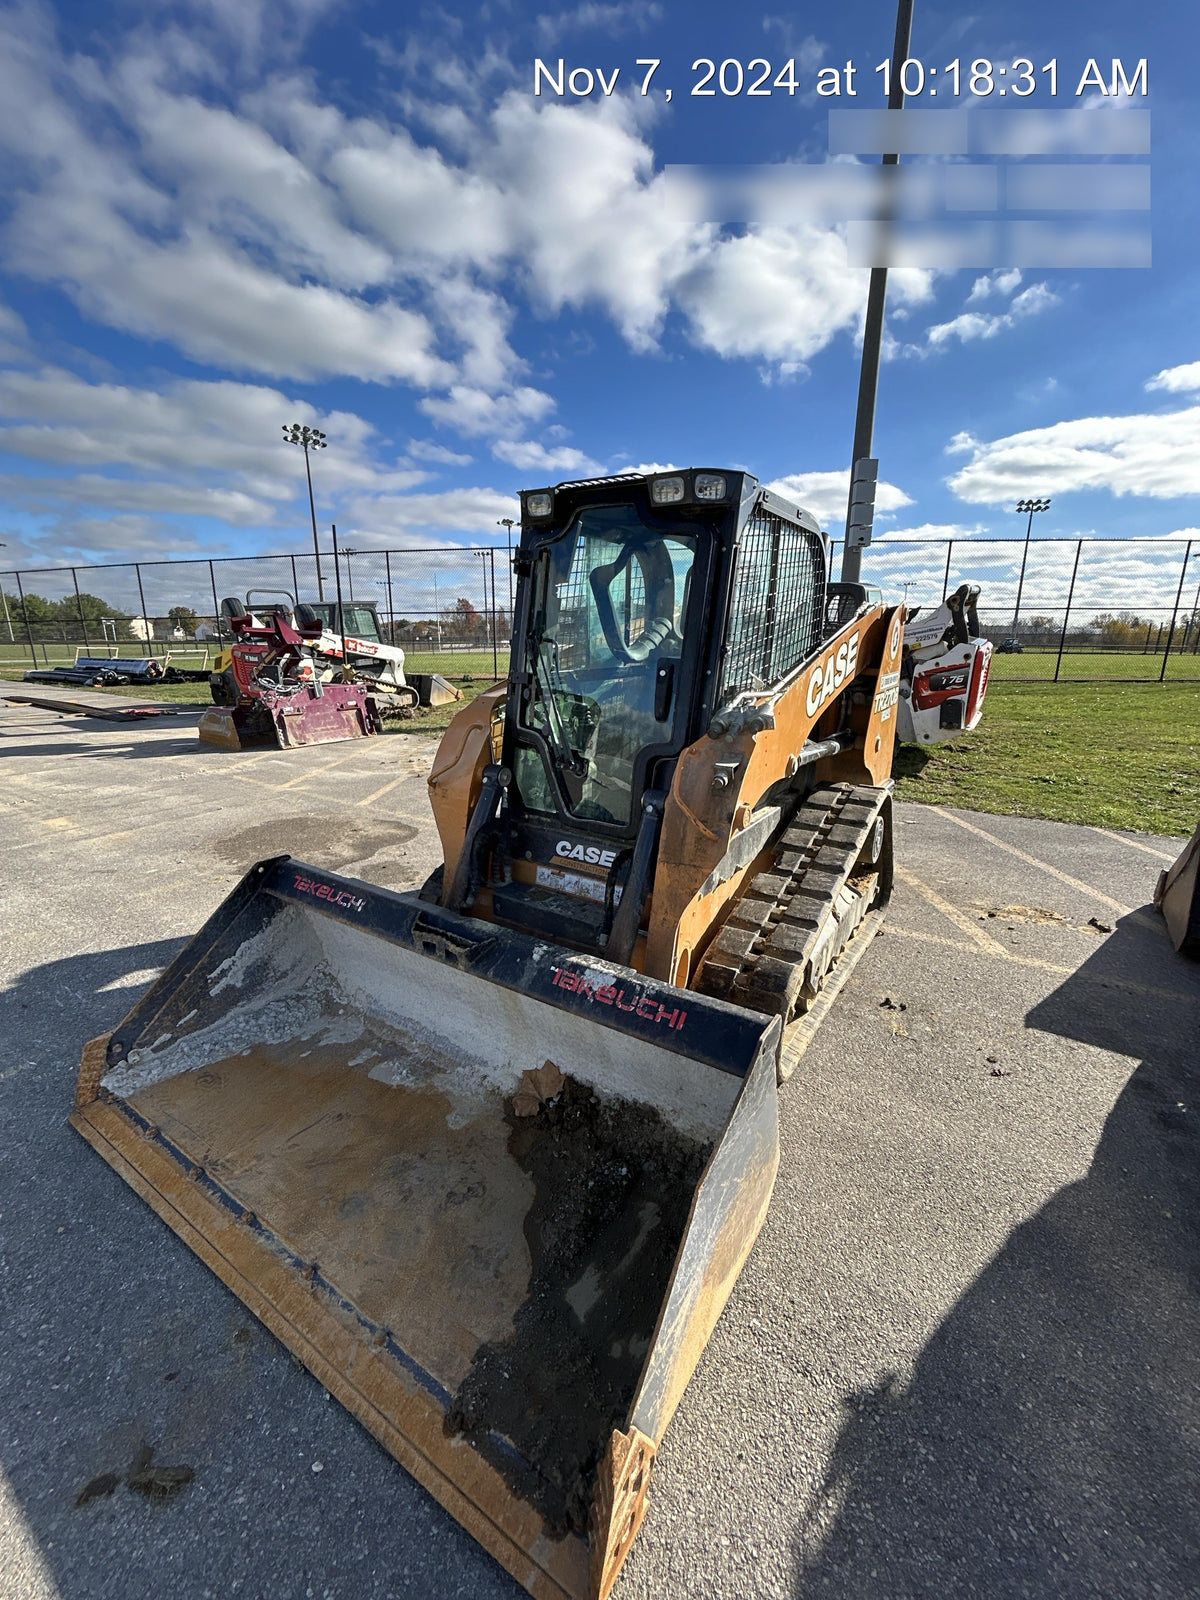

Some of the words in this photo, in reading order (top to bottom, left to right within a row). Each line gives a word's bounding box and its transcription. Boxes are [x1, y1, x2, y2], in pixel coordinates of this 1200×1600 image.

[806, 629, 860, 718] CASE
[941, 674, 965, 685] T76
[555, 840, 617, 868] CASE
[560, 858, 609, 876] CONSTRUCTION
